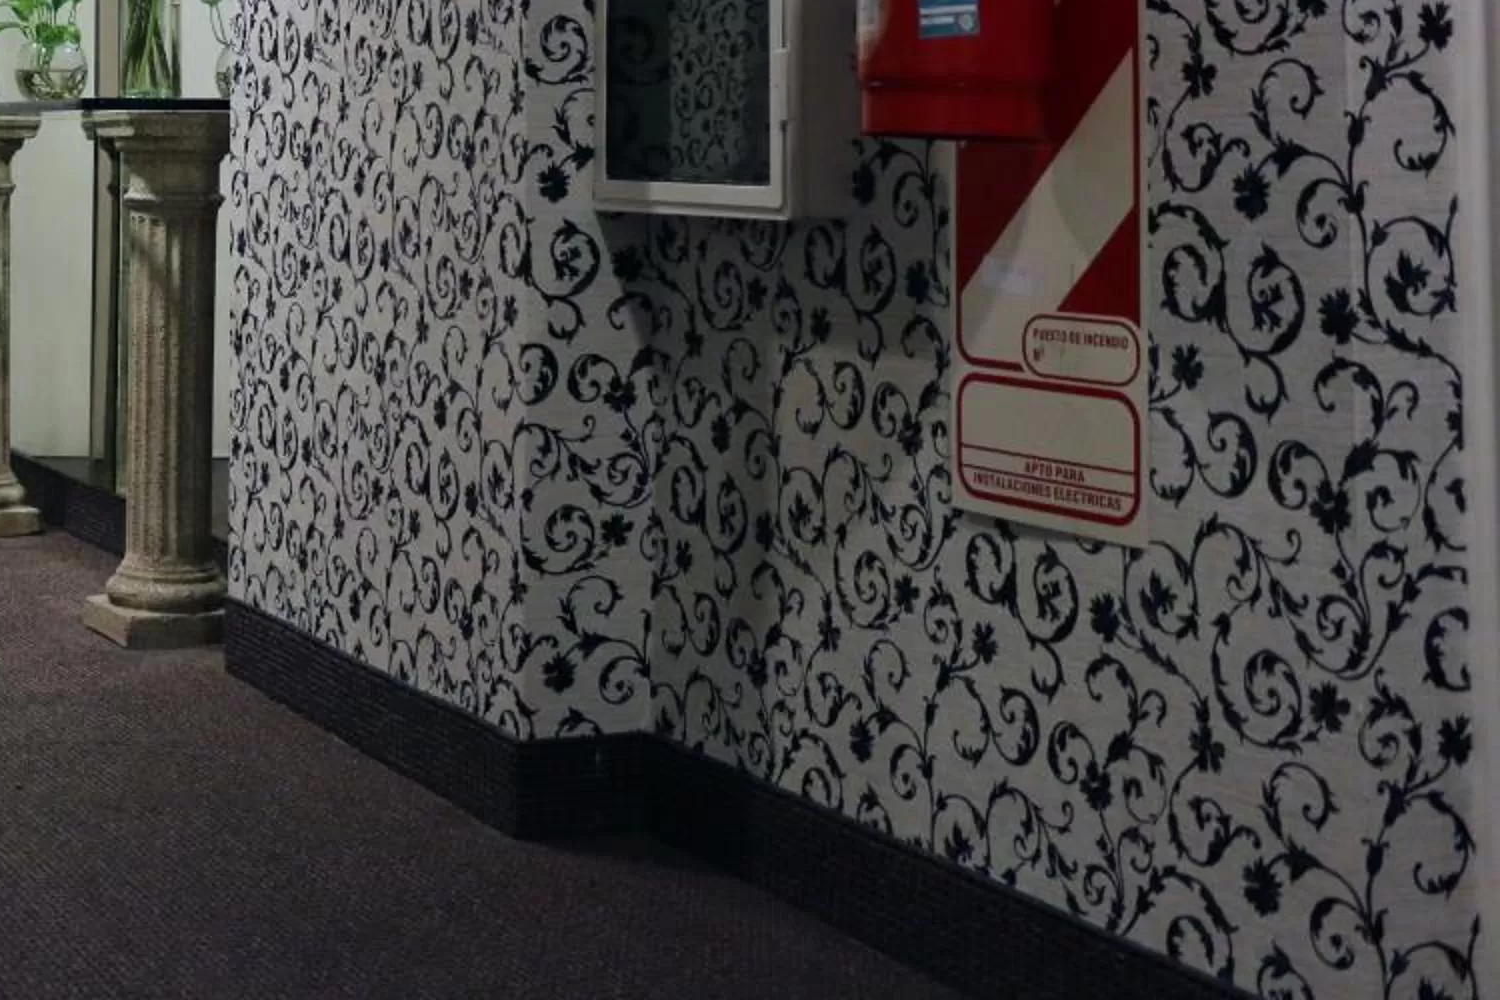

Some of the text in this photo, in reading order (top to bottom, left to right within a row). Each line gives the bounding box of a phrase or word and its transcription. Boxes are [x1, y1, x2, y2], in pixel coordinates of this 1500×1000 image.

[1032, 328, 1128, 350] PUESTO DE INCENDIO
[1024, 461, 1085, 482] APTO PARA
[973, 471, 1122, 511] INSTALACIONES ELECTRICAS
